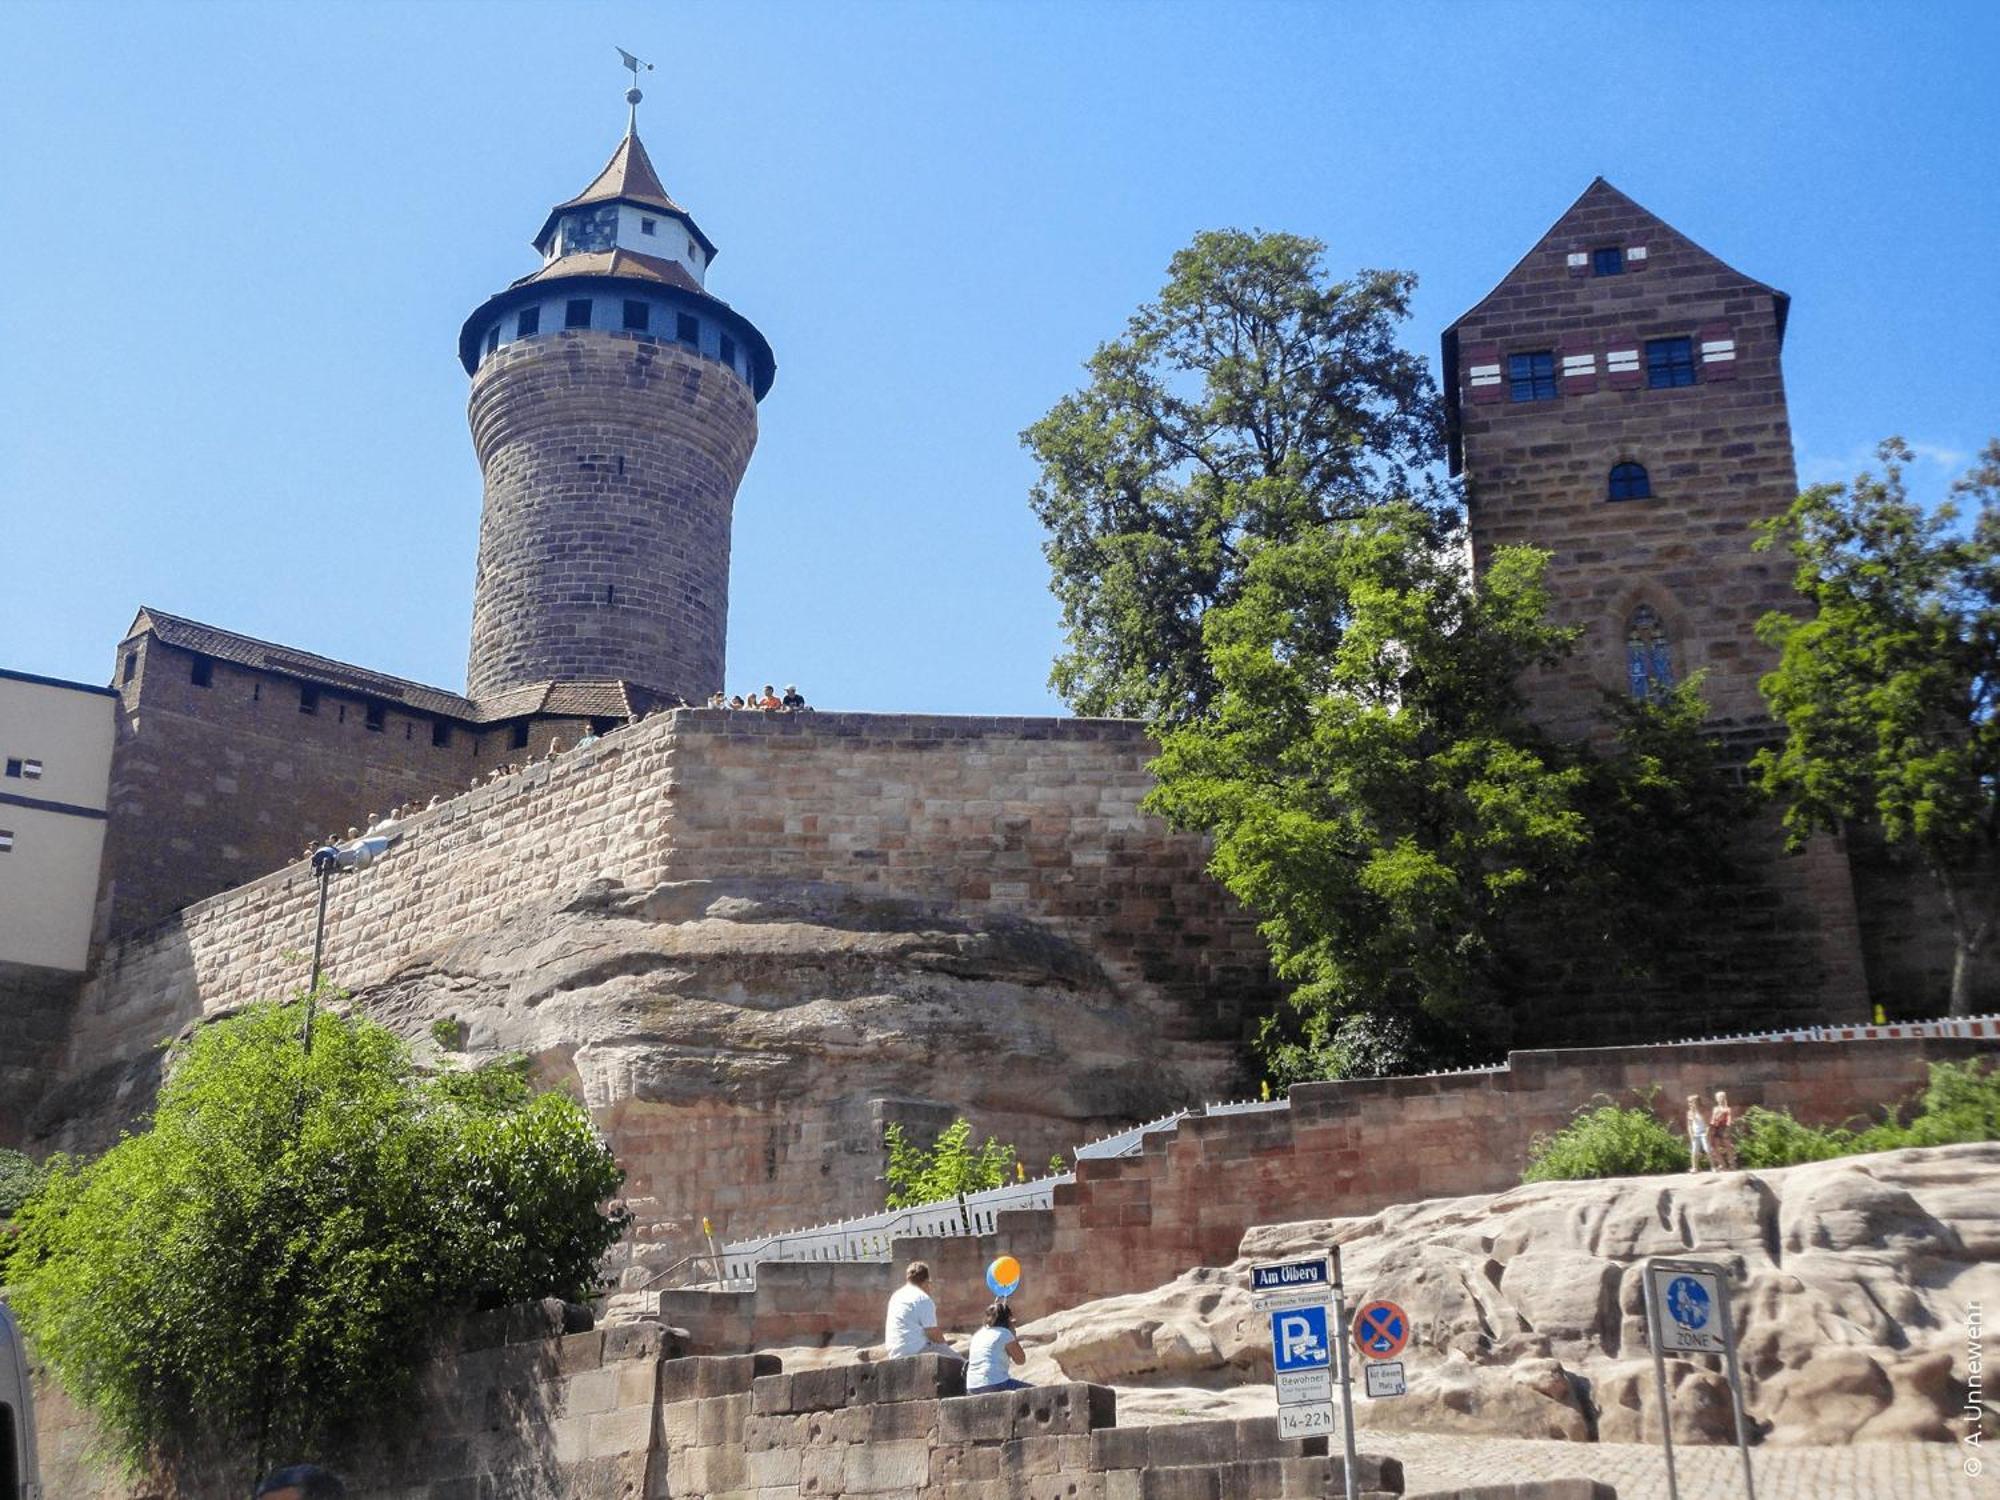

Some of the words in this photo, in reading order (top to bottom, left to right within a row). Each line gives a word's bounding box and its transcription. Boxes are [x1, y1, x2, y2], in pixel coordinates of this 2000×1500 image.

[1260, 1269, 1279, 1285] Am
[1281, 1265, 1318, 1282] Ölberg
[1281, 1316, 1311, 1363] P
[1676, 1332, 1710, 1347] ZONE
[1281, 1375, 1325, 1386] Bewohner
[1283, 1412, 1322, 1429] 14-22
[1323, 1411, 1331, 1425] h
